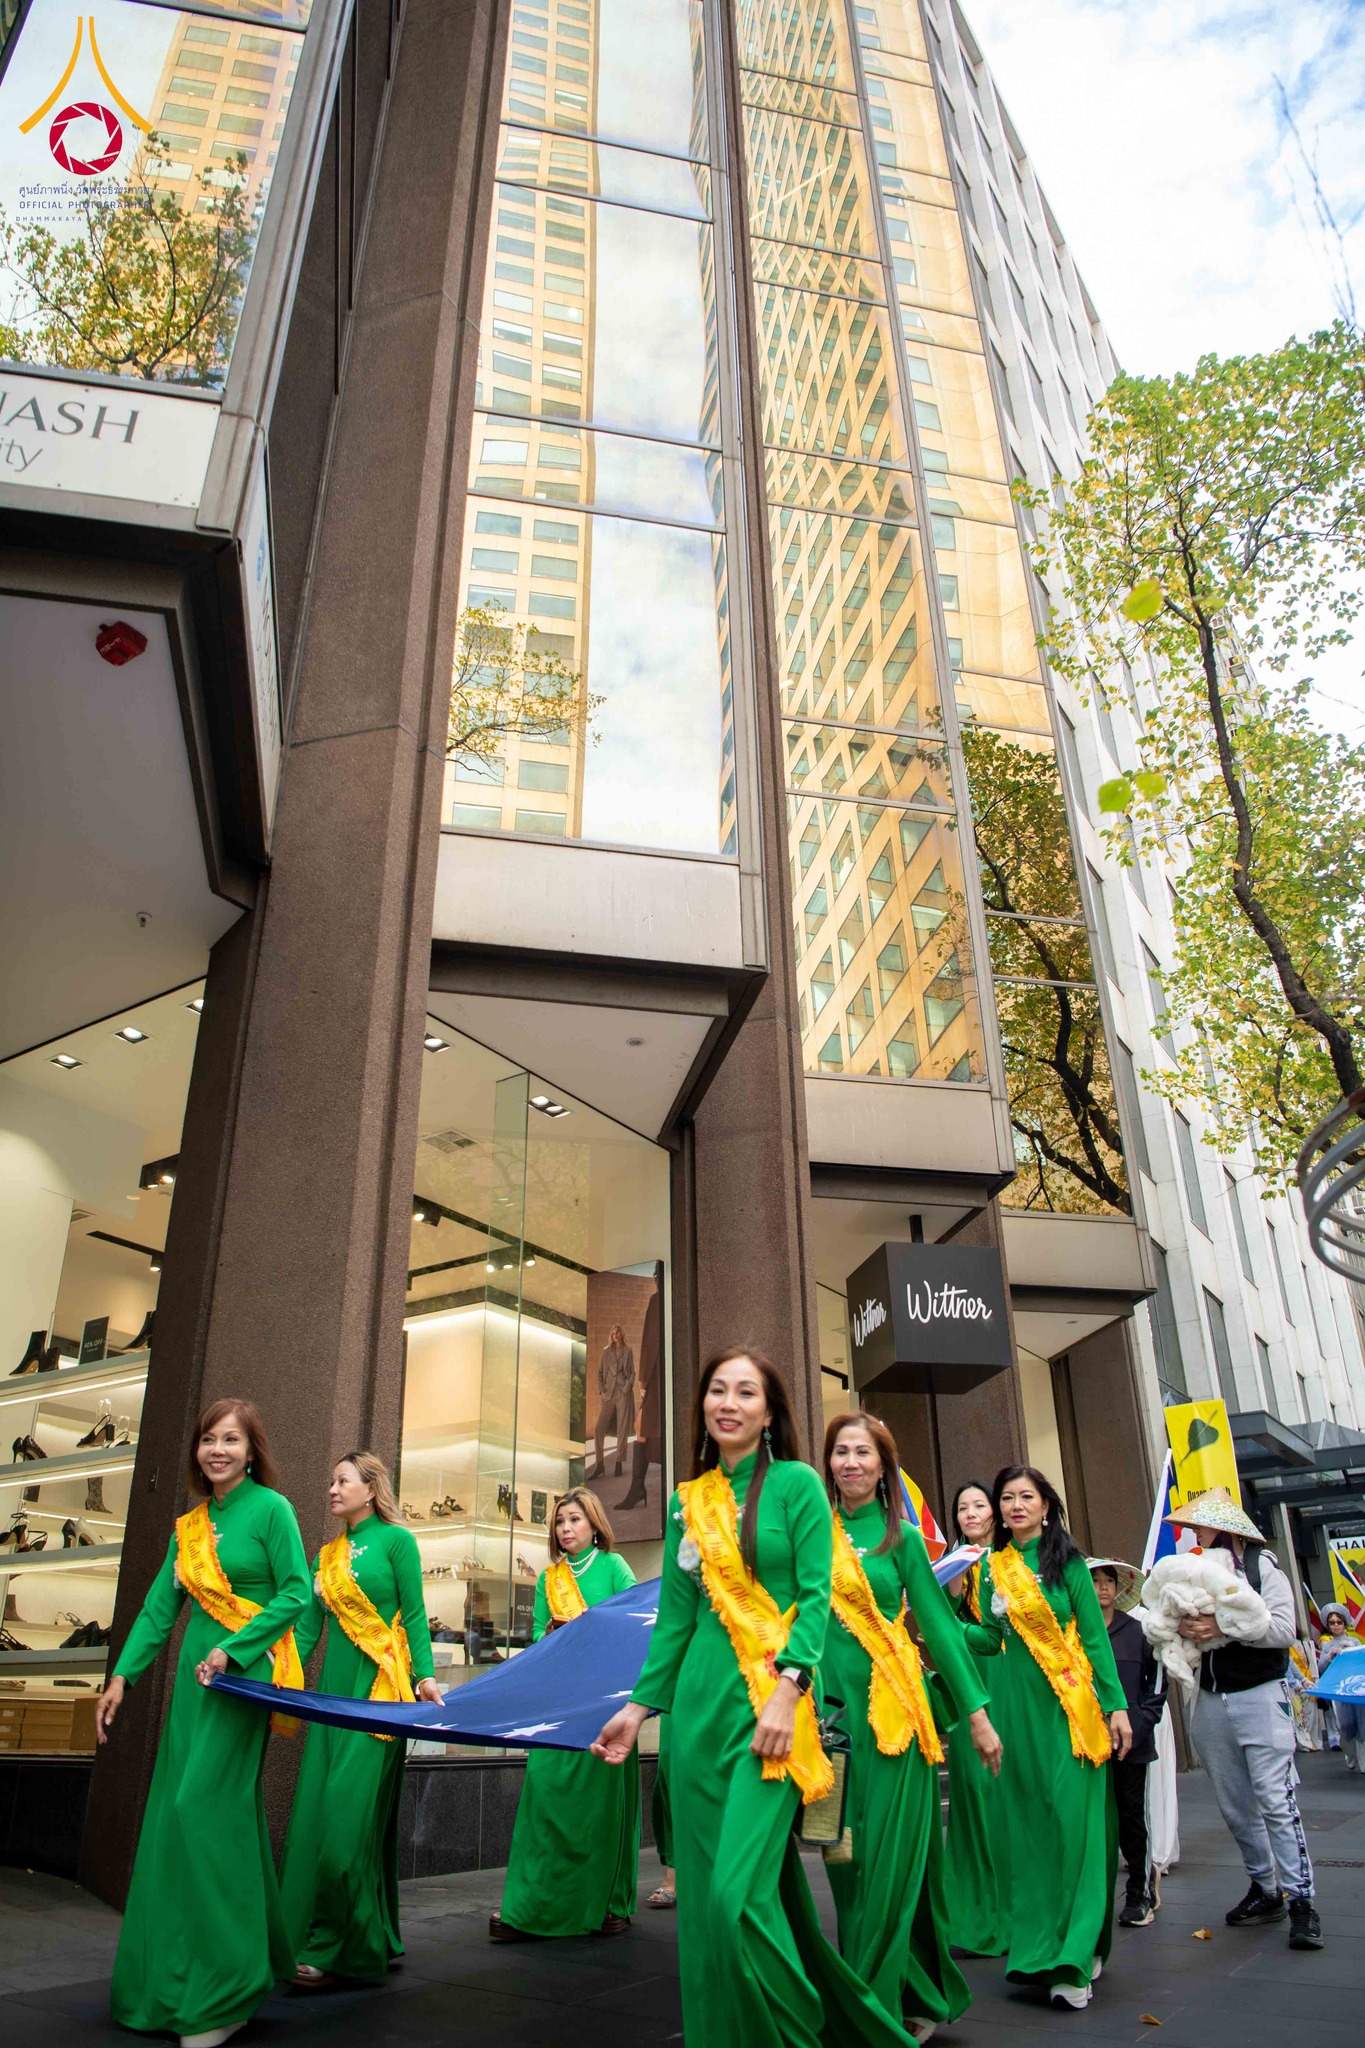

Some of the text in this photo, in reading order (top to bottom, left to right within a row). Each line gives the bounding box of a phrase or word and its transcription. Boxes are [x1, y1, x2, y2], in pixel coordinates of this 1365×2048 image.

[853, 1298, 887, 1347] Wittner
[906, 1280, 993, 1324] Wittner
[94, 1339, 104, 1347] OFF
